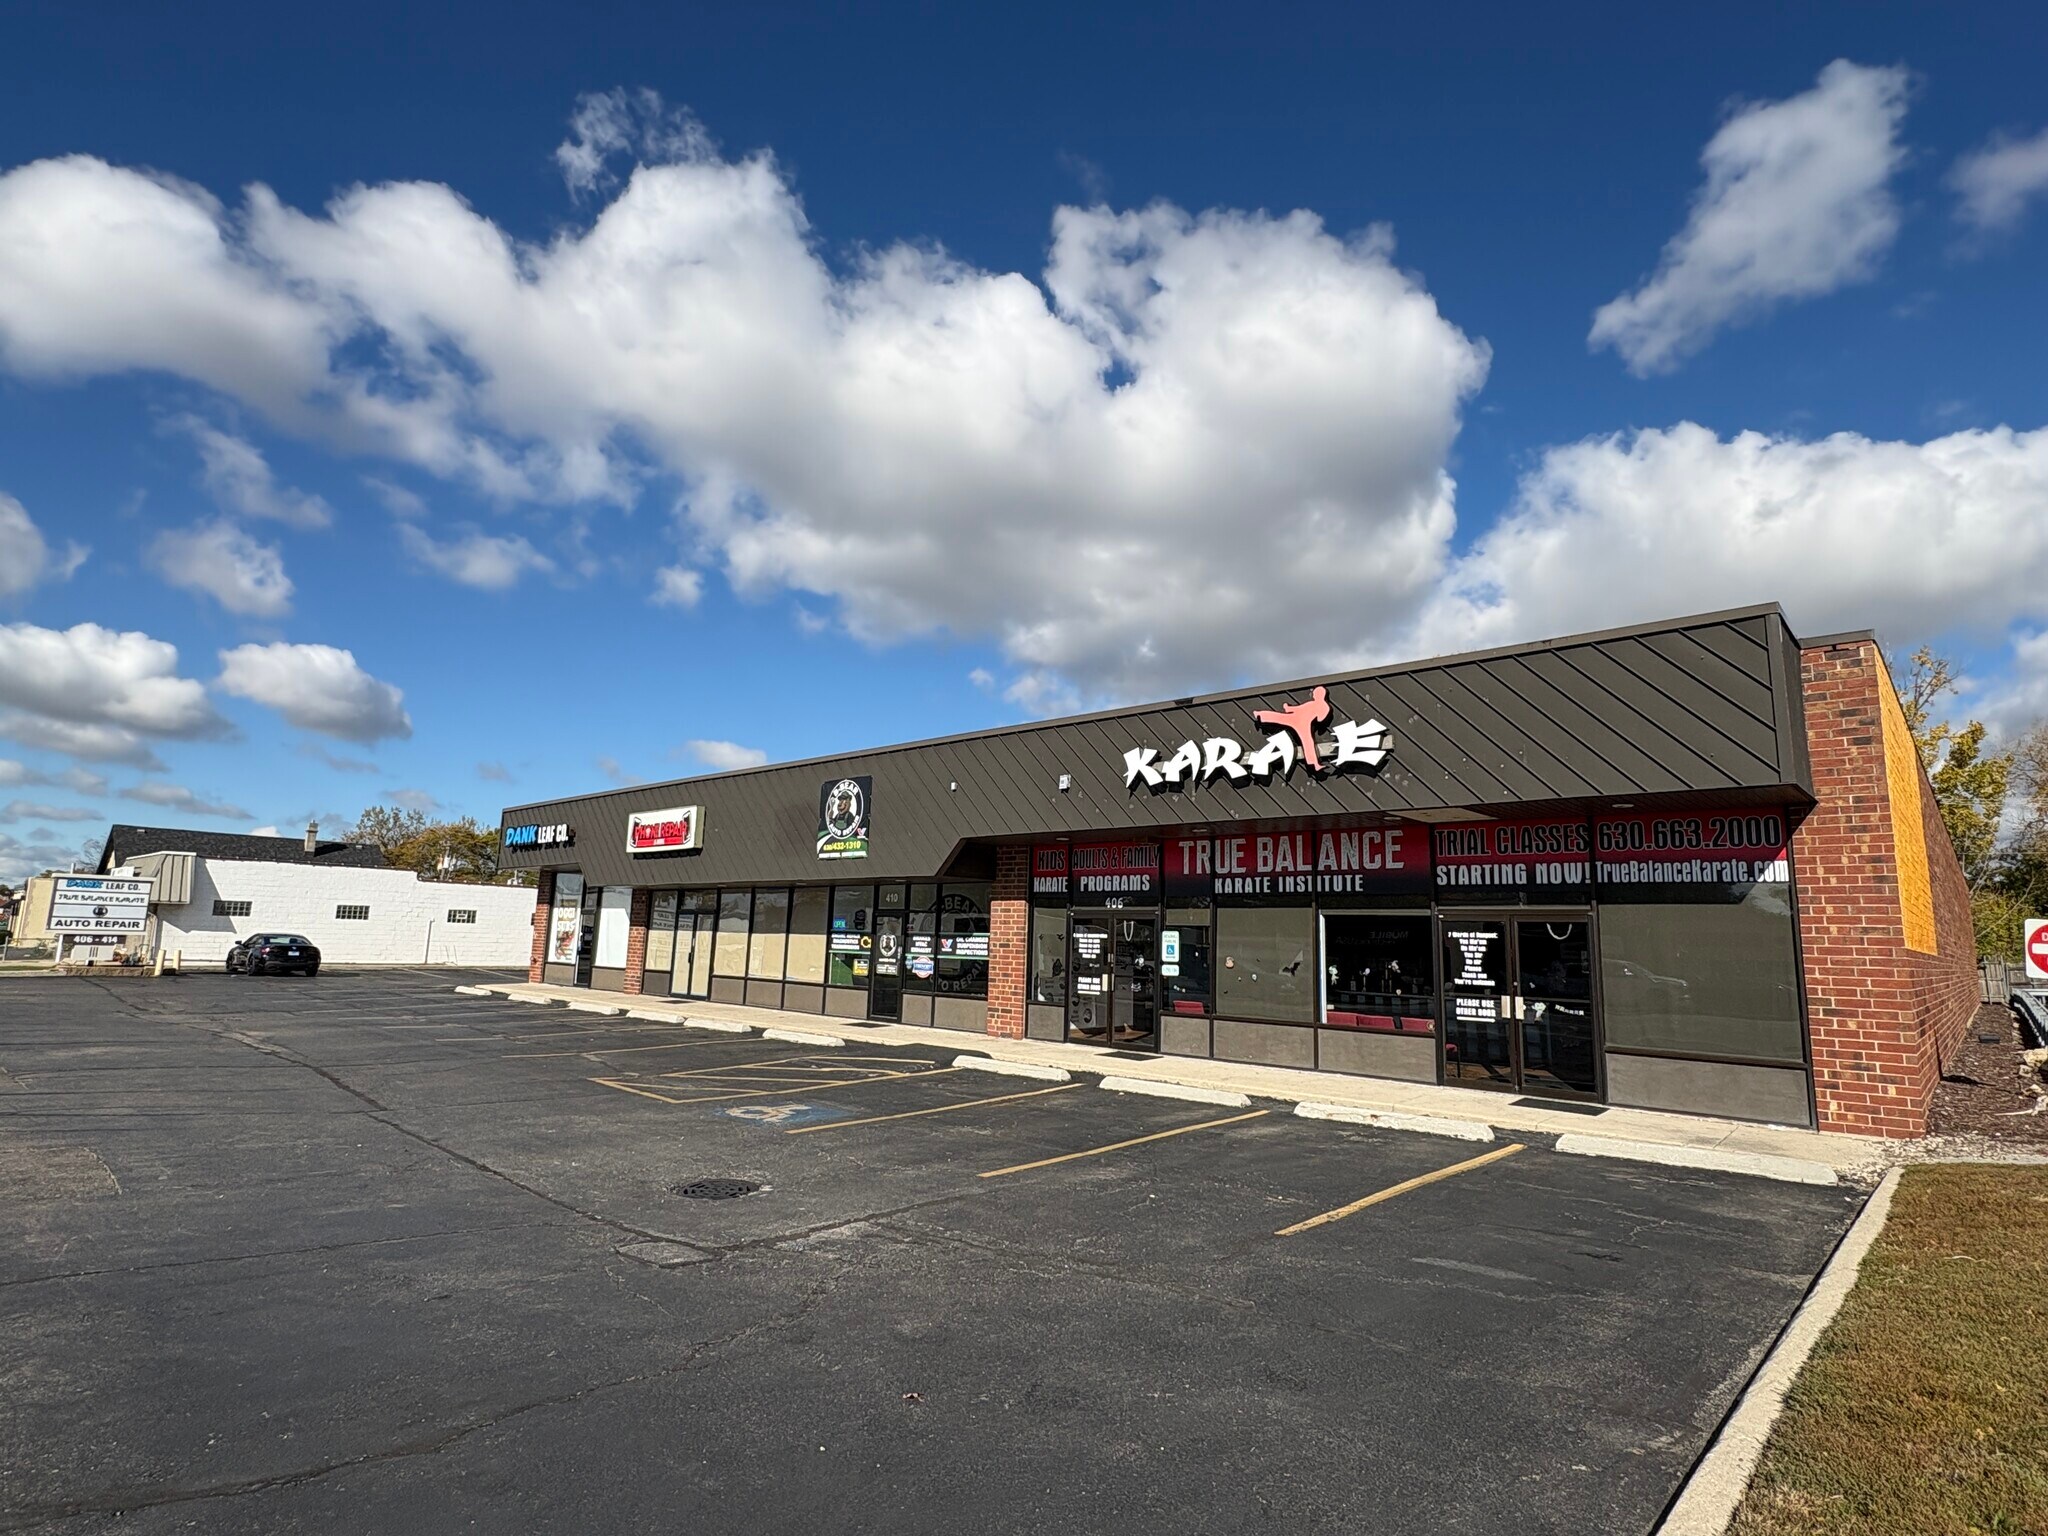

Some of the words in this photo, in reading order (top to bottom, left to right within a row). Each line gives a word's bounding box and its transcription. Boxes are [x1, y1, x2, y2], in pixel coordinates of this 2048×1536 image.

[1123, 686, 1388, 788] KARATE
[505, 823, 539, 847] DANK
[537, 824, 555, 844] LEAF
[556, 823, 569, 842] CO.
[635, 823, 660, 841] PHONE
[661, 820, 687, 838] REPAIR
[1435, 827, 1491, 857] TRIAL
[1495, 822, 1589, 856] CLASSES
[1597, 814, 1782, 852] 630.663.2000
[1037, 849, 1066, 871] KIDS
[1072, 848, 1109, 871] ADULTS
[1110, 846, 1119, 869] &
[1120, 843, 1161, 869] FAMILY
[1178, 838, 1247, 875] TRUE
[1256, 830, 1405, 873] BALANCE
[1436, 862, 1528, 886] STARTING
[1536, 861, 1592, 885] NOW!
[1596, 857, 1790, 884] TrueBalanceKarate.com
[106, 882, 125, 890] LEAF
[127, 883, 141, 891] CO.
[1033, 876, 1068, 893] KARATE
[1080, 874, 1150, 892] PROGRAMS
[1214, 876, 1271, 894] KARATE
[1278, 874, 1364, 893] INSTITUTE
[58, 893, 79, 901] TRUE
[80, 894, 114, 903] BALANCE
[115, 896, 145, 904] KARATE
[886, 893, 898, 902] 410
[1105, 897, 1124, 909] 406
[55, 919, 91, 928] AUTO
[95, 920, 140, 929] REPAIR
[73, 935, 93, 943] 406
[101, 935, 118, 944] 414
[1456, 998, 1480, 1007] PLEASE
[1481, 999, 1495, 1008] USE
[1456, 1006, 1477, 1016] OTHER
